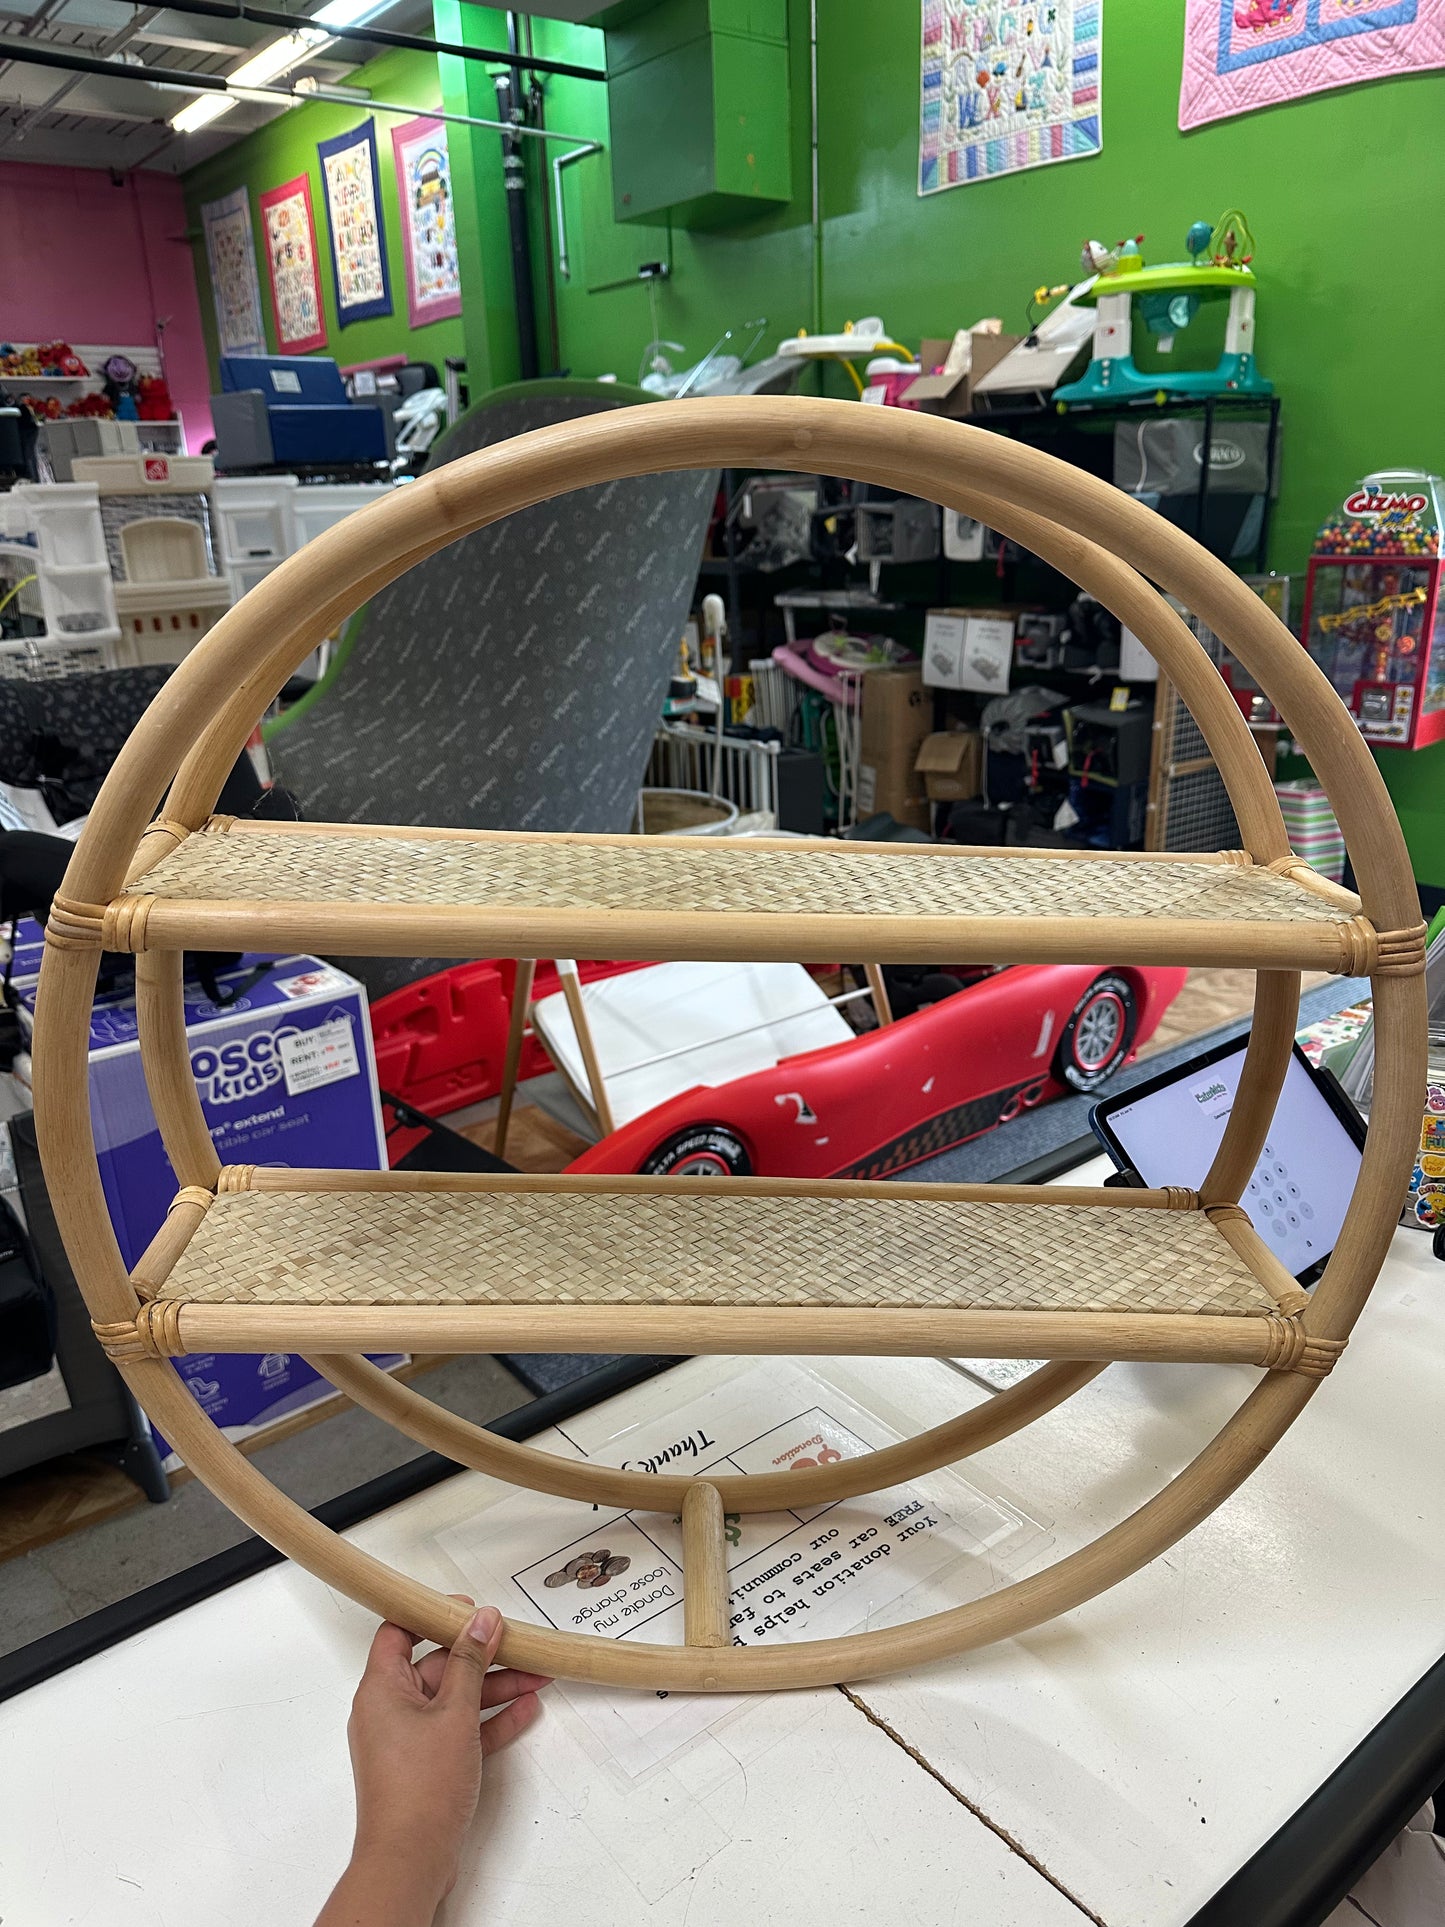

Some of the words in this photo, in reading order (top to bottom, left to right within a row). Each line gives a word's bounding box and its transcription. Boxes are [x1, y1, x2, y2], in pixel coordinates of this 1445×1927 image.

[1346, 493, 1427, 513] GIZMO
[213, 1062, 279, 1100] kids
[233, 1104, 286, 1131] extend
[637, 1429, 716, 1474] Thank
[772, 1433, 824, 1466] Donation
[883, 1499, 925, 1529] FREE
[897, 1514, 939, 1544] Your
[809, 1527, 840, 1552] our
[848, 1526, 878, 1551] car
[630, 1565, 673, 1594] loose
[727, 1551, 803, 1606] communit
[791, 1550, 842, 1586] seats
[812, 1543, 892, 1598] donation
[570, 1590, 626, 1626] change
[622, 1583, 676, 1617] Donate
[762, 1588, 787, 1606] to
[593, 1610, 621, 1633] my
[753, 1597, 811, 1638] helps
